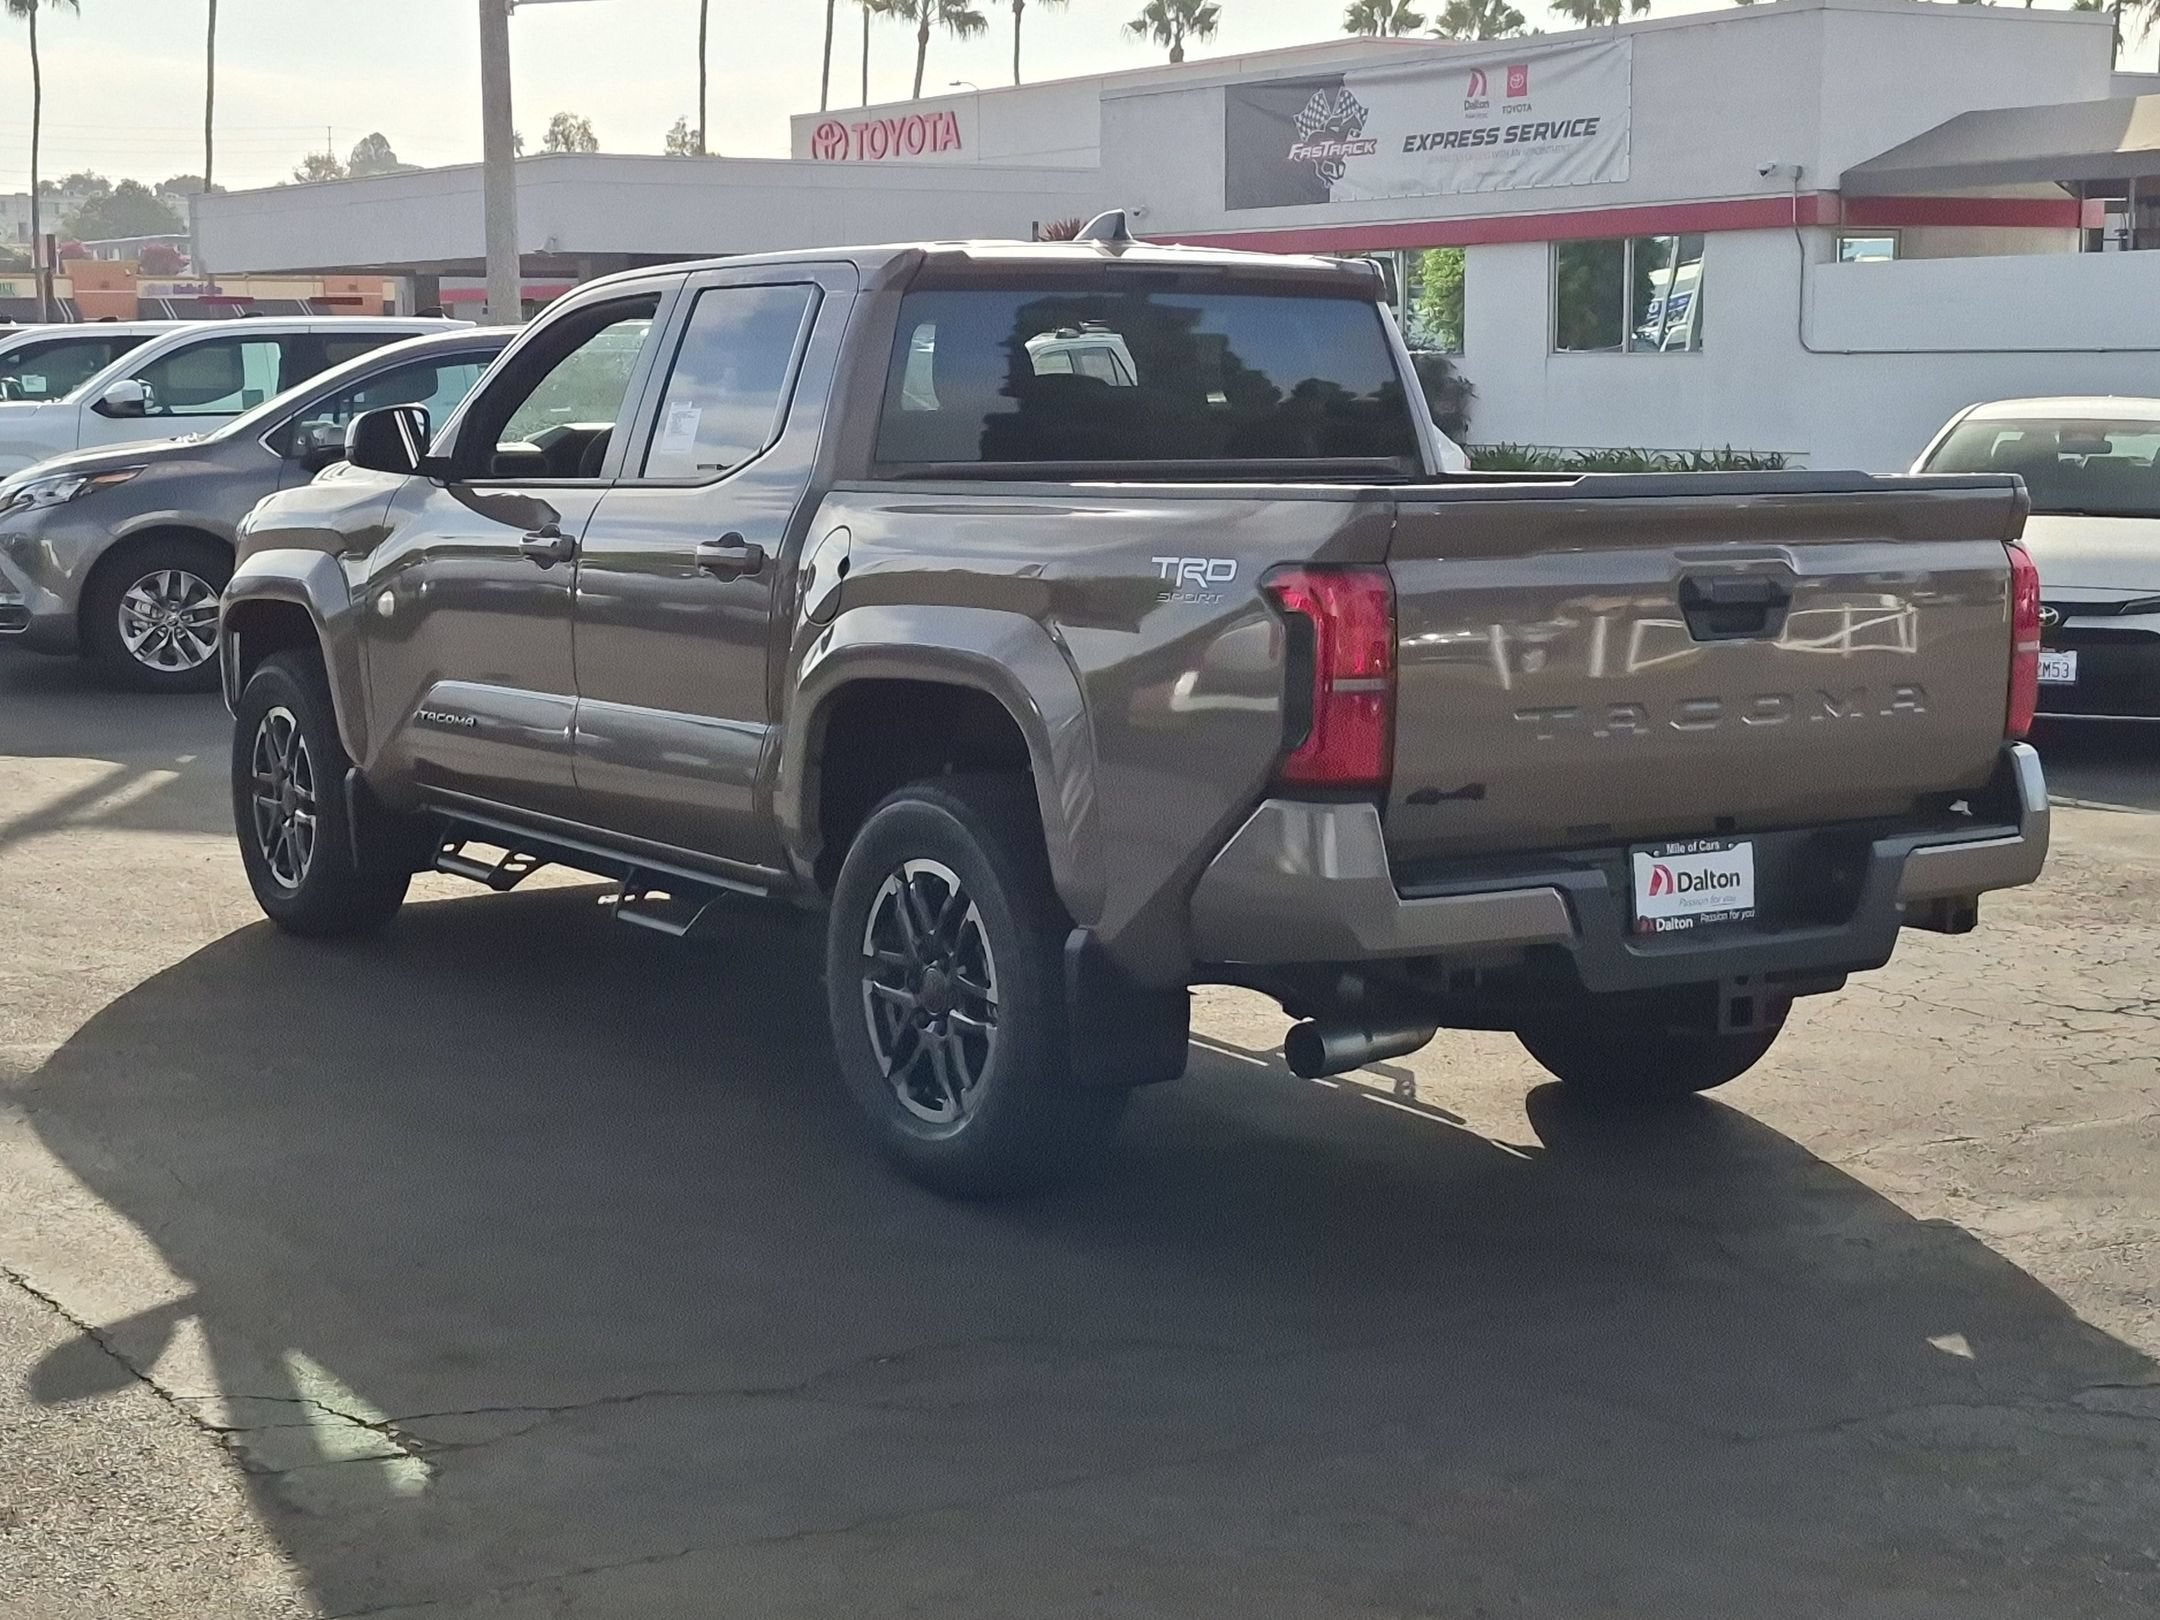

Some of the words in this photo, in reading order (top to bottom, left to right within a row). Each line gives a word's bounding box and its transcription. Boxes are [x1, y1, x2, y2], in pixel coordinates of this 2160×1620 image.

[1502, 103, 1532, 114] TOYOTA
[851, 111, 962, 160] TOYOTA
[1402, 126, 1501, 153] EXPRESS
[1503, 117, 1601, 144] SERVICE
[1151, 556, 1238, 589] TRD
[1157, 592, 1224, 604] SPORT
[420, 709, 476, 728] TACOMA
[1513, 684, 1928, 741] TACOMA
[1666, 843, 1685, 855] Mile
[1687, 841, 1697, 852] of
[1699, 840, 1720, 851] Cars
[1677, 869, 1741, 892] Dalton
[1656, 917, 1694, 932] Dalton
[1729, 911, 1740, 920] for
[1741, 910, 1755, 921] you
